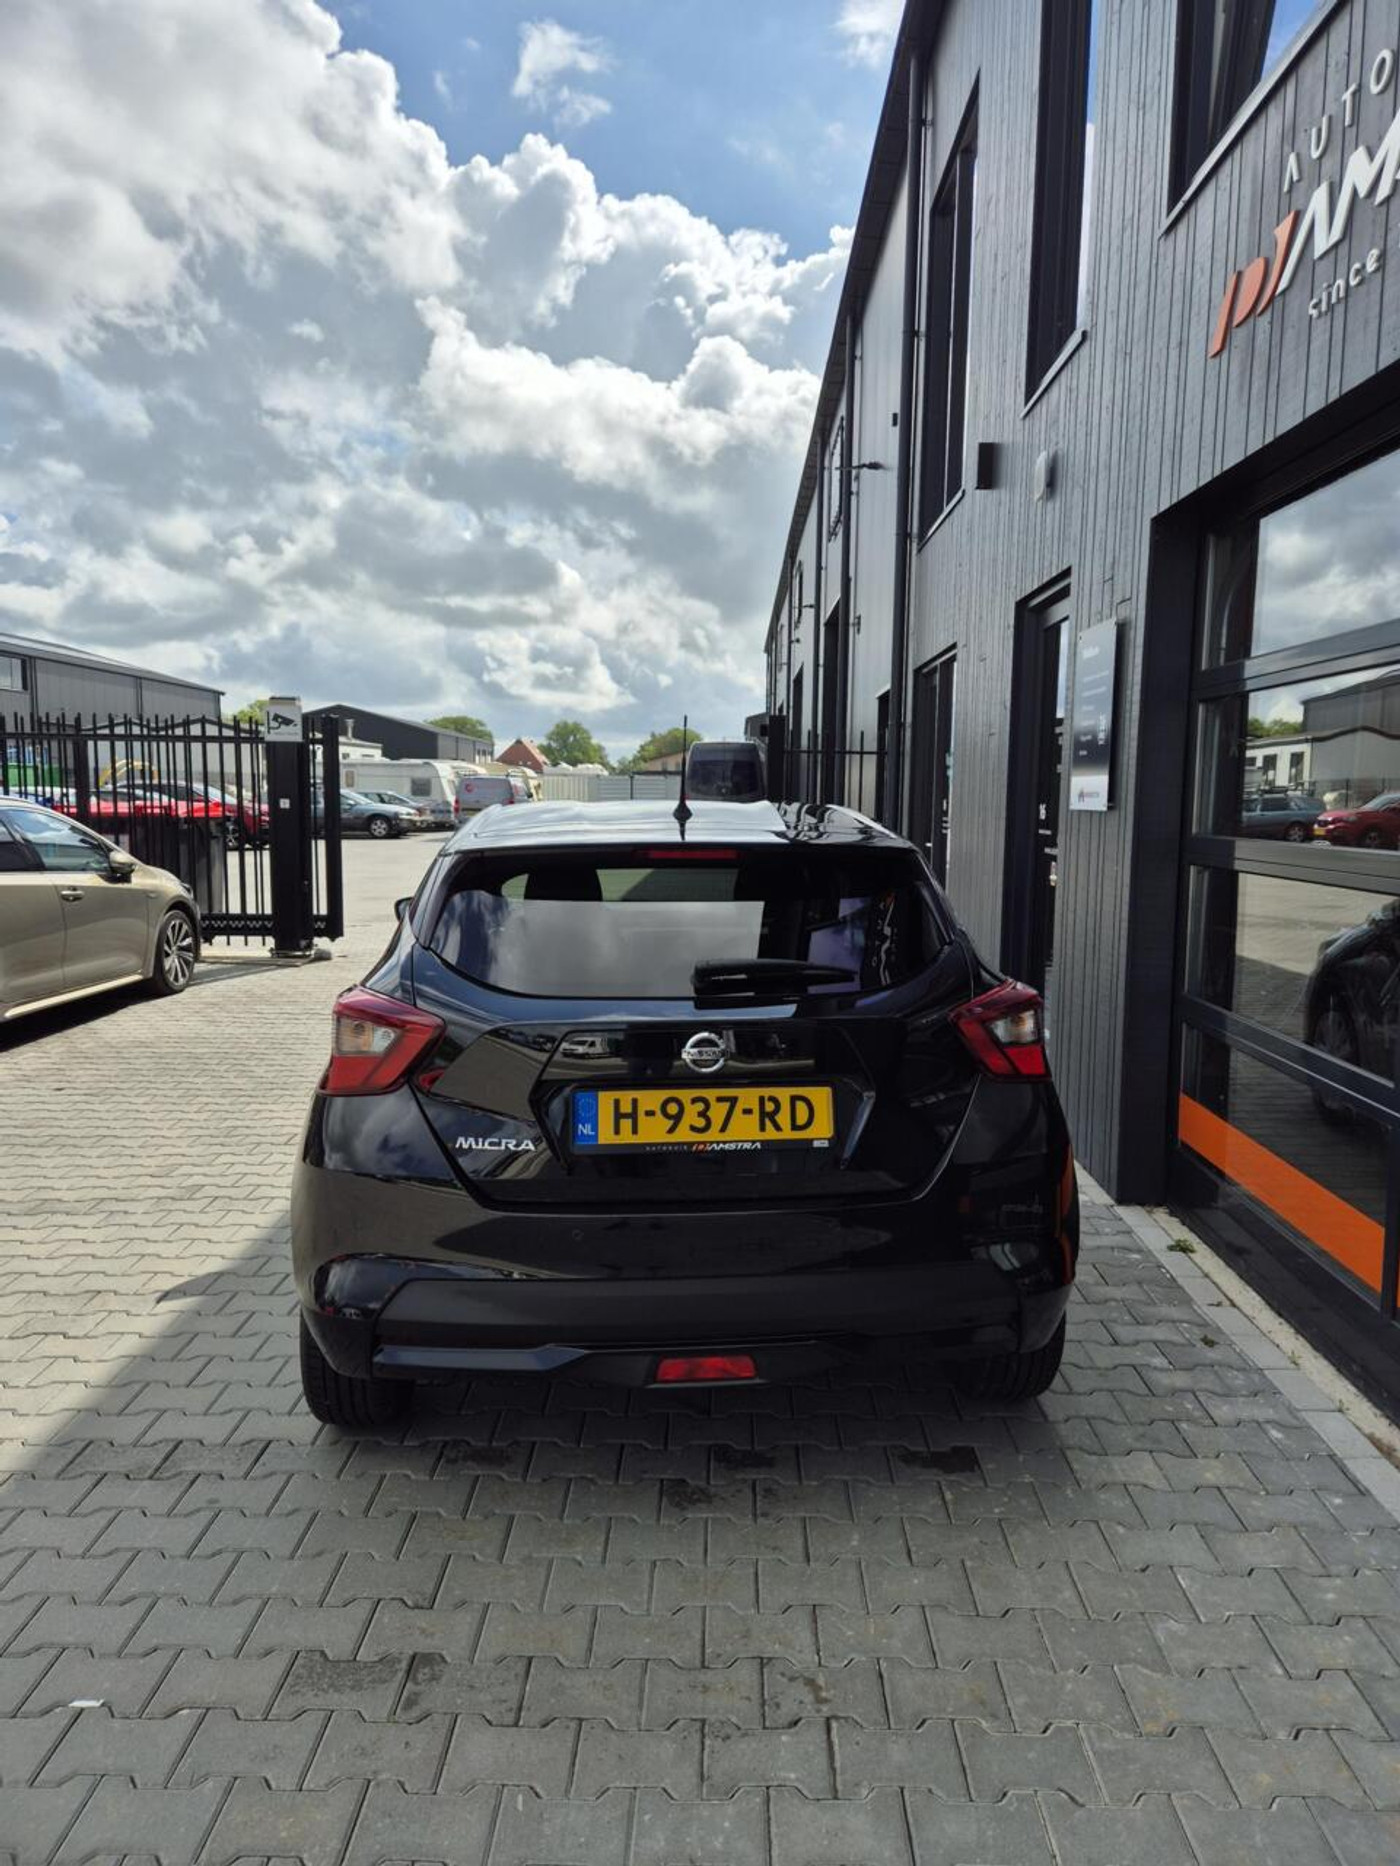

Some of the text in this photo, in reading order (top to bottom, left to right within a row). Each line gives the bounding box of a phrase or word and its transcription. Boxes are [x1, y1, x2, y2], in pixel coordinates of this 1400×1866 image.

[1283, 49, 1393, 193] AUTO
[1308, 248, 1382, 319] since
[578, 1124, 595, 1136] NL
[612, 1094, 816, 1136] H-937-RD
[455, 1136, 536, 1151] MICRA
